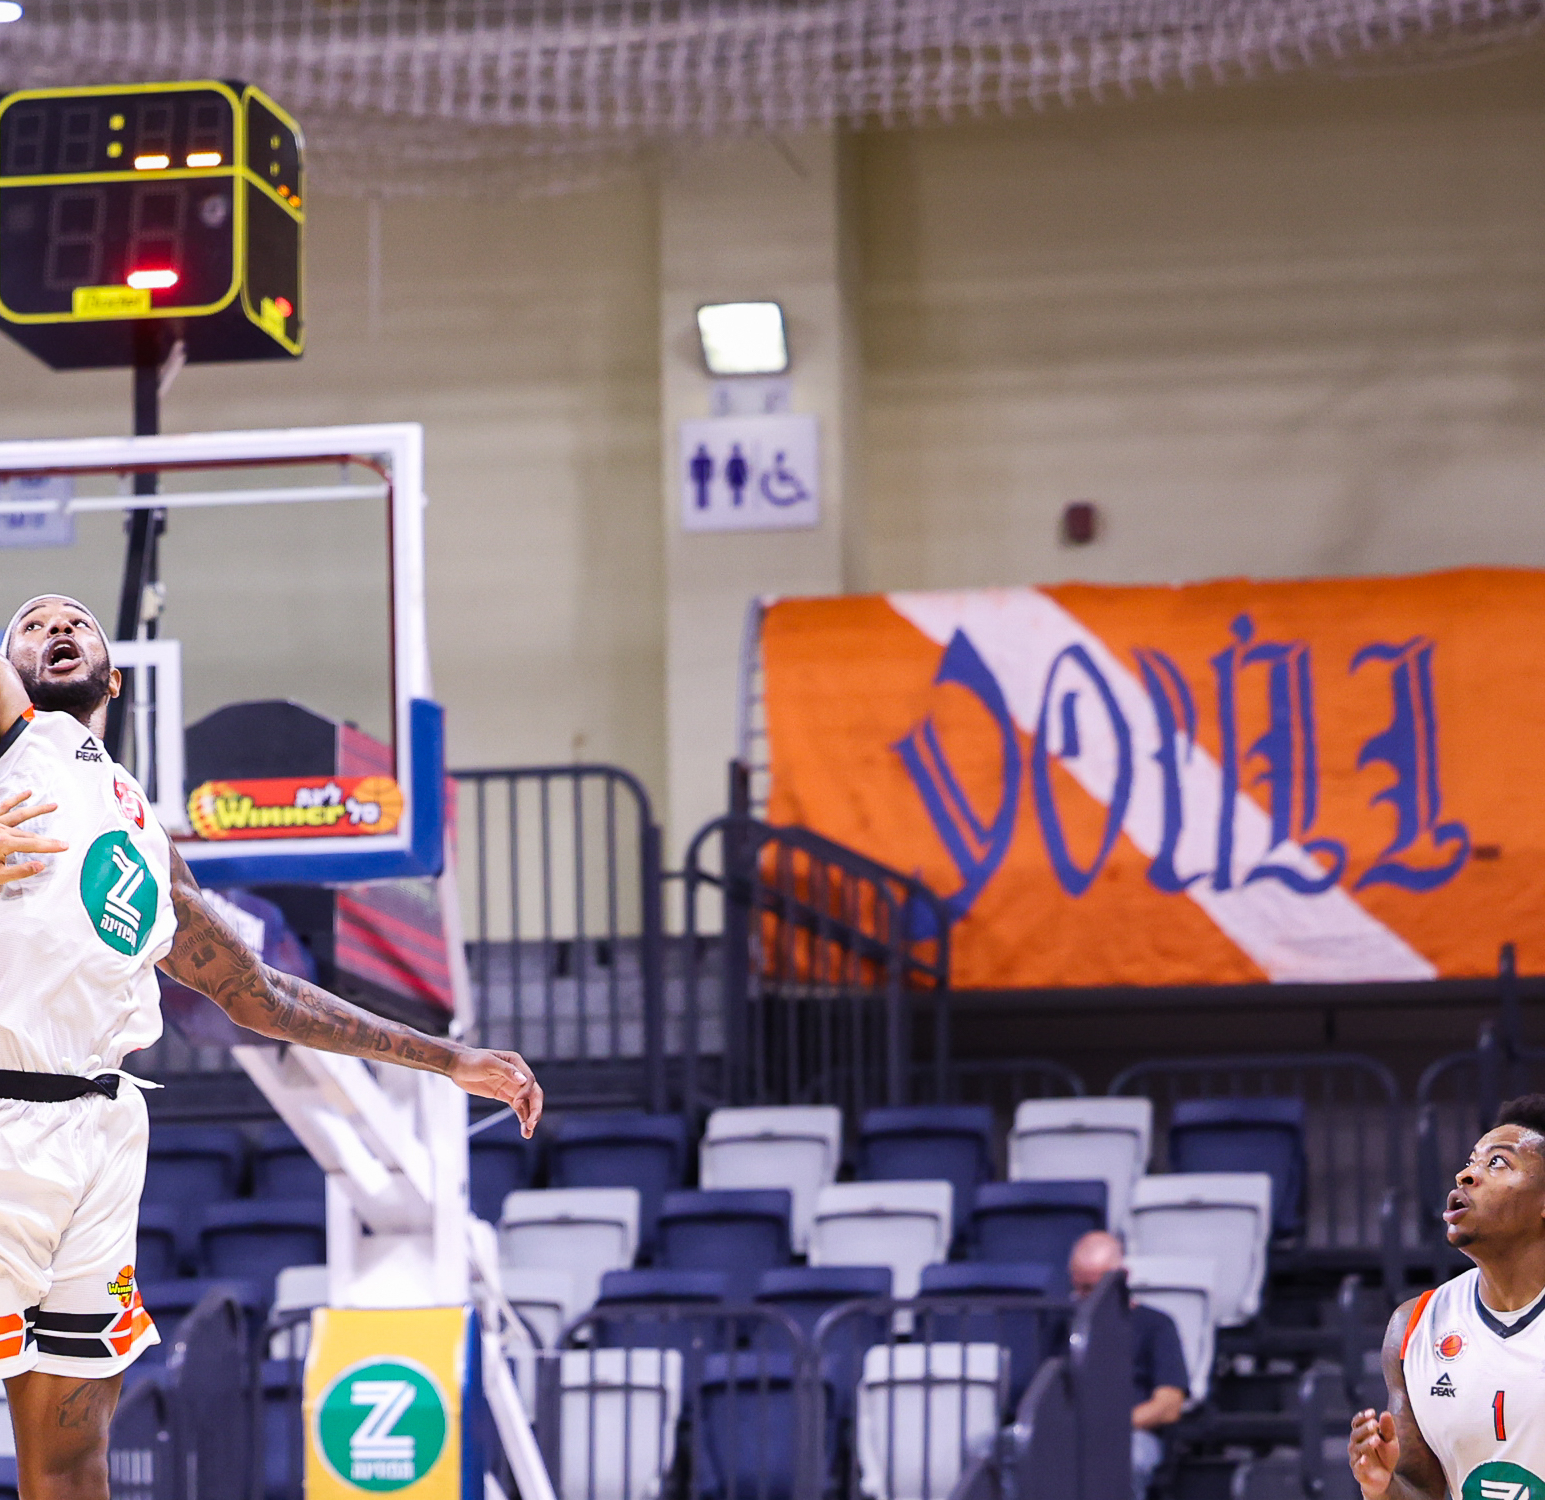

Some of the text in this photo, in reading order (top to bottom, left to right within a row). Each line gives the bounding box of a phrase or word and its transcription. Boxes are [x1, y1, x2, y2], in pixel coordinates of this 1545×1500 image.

[75, 750, 103, 762] PEAK
[215, 795, 345, 829] Winner
[1430, 1386, 1457, 1397] PEAK
[1492, 1390, 1507, 1441] 1
